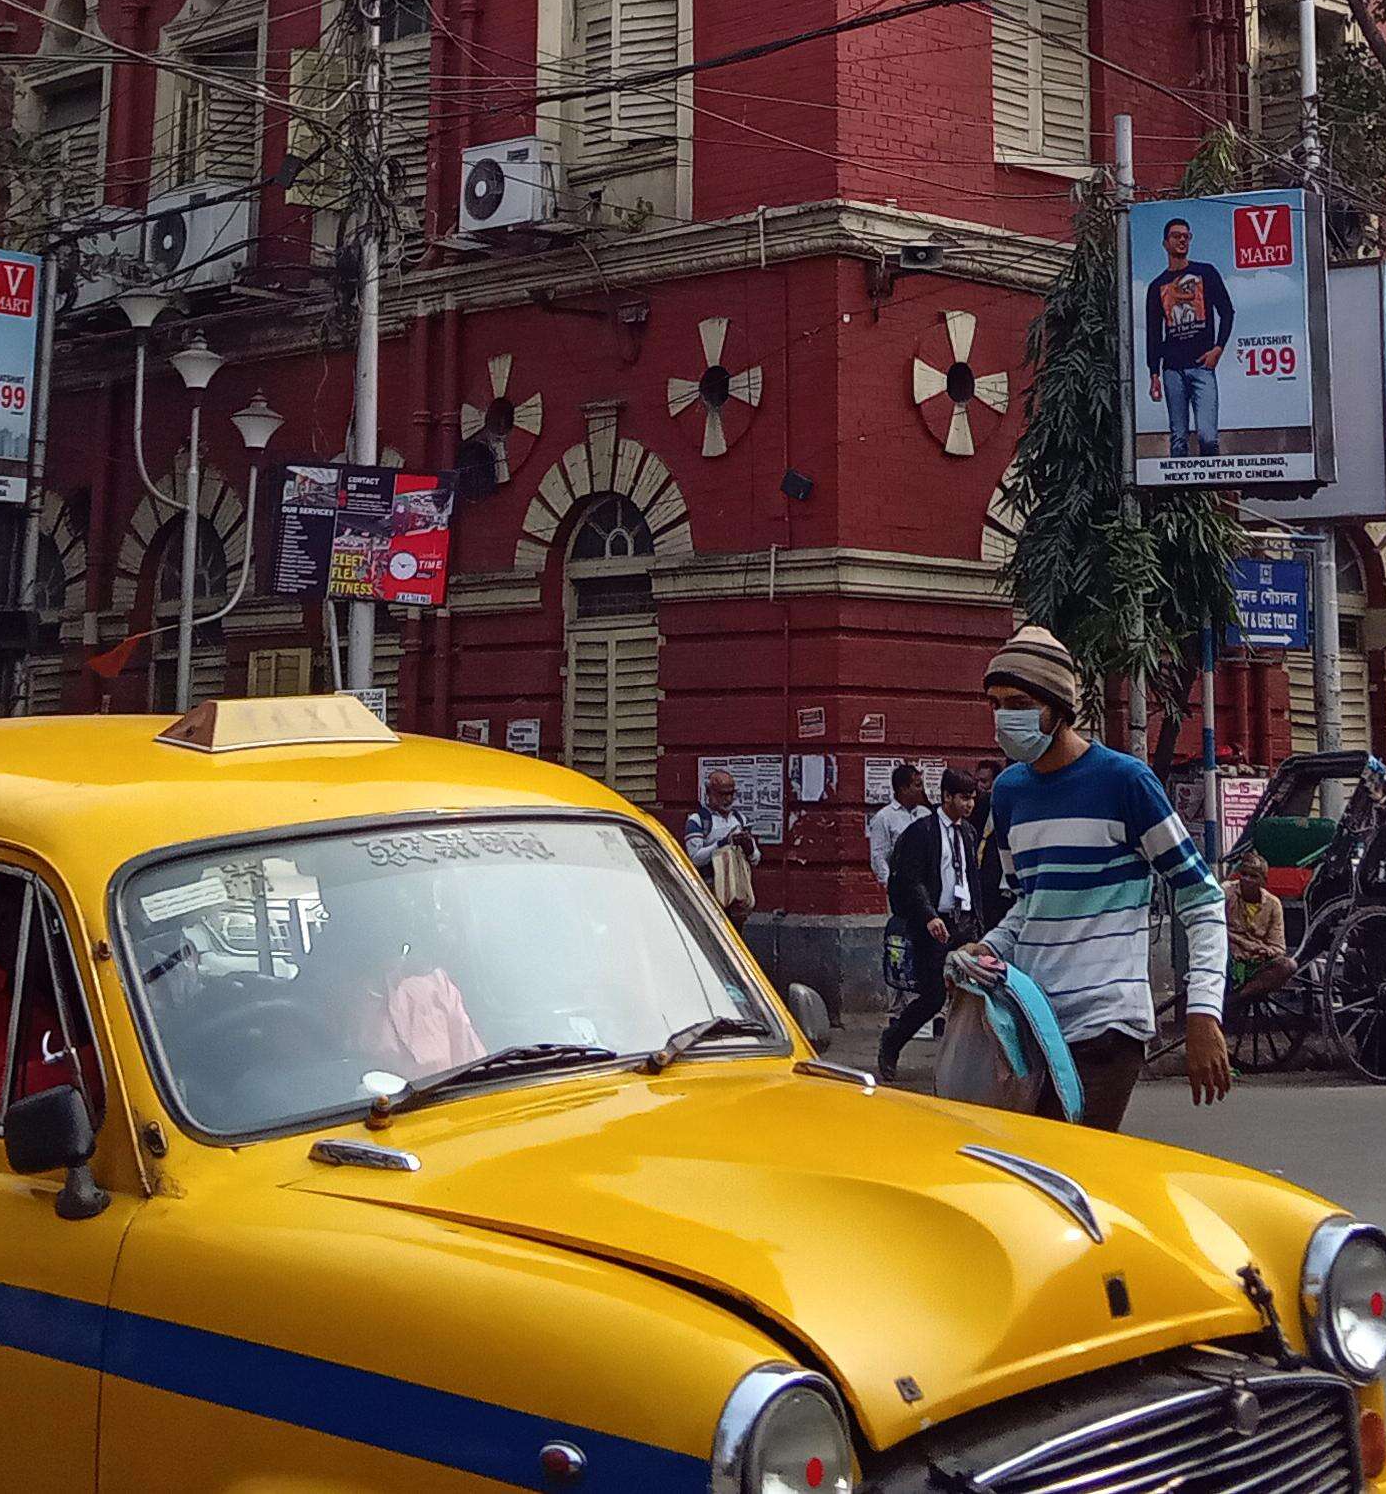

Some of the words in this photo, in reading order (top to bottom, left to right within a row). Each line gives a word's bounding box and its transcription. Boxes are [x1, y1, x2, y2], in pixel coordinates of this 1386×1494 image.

[1246, 209, 1278, 245] V
[1240, 245, 1288, 265] MART
[3, 265, 27, 296] V
[1237, 335, 1293, 348] SWEATSHIRT
[1159, 459, 1235, 470] METROPOLITAN
[1236, 457, 1289, 468] BUILDING,
[347, 476, 380, 486] CONTACT
[1164, 472, 1191, 482] NEXT
[1192, 471, 1206, 480] TO
[1208, 470, 1243, 480] METRO
[1244, 469, 1285, 479] CINEMA
[281, 506, 297, 514] OUR
[298, 506, 335, 516] SERVICES
[333, 553, 365, 566] FLEET
[418, 560, 443, 569] TIME
[329, 581, 374, 595] FITNESS
[1250, 612, 1257, 628] &
[1257, 612, 1273, 629] USE
[1273, 613, 1298, 630] TOILET
